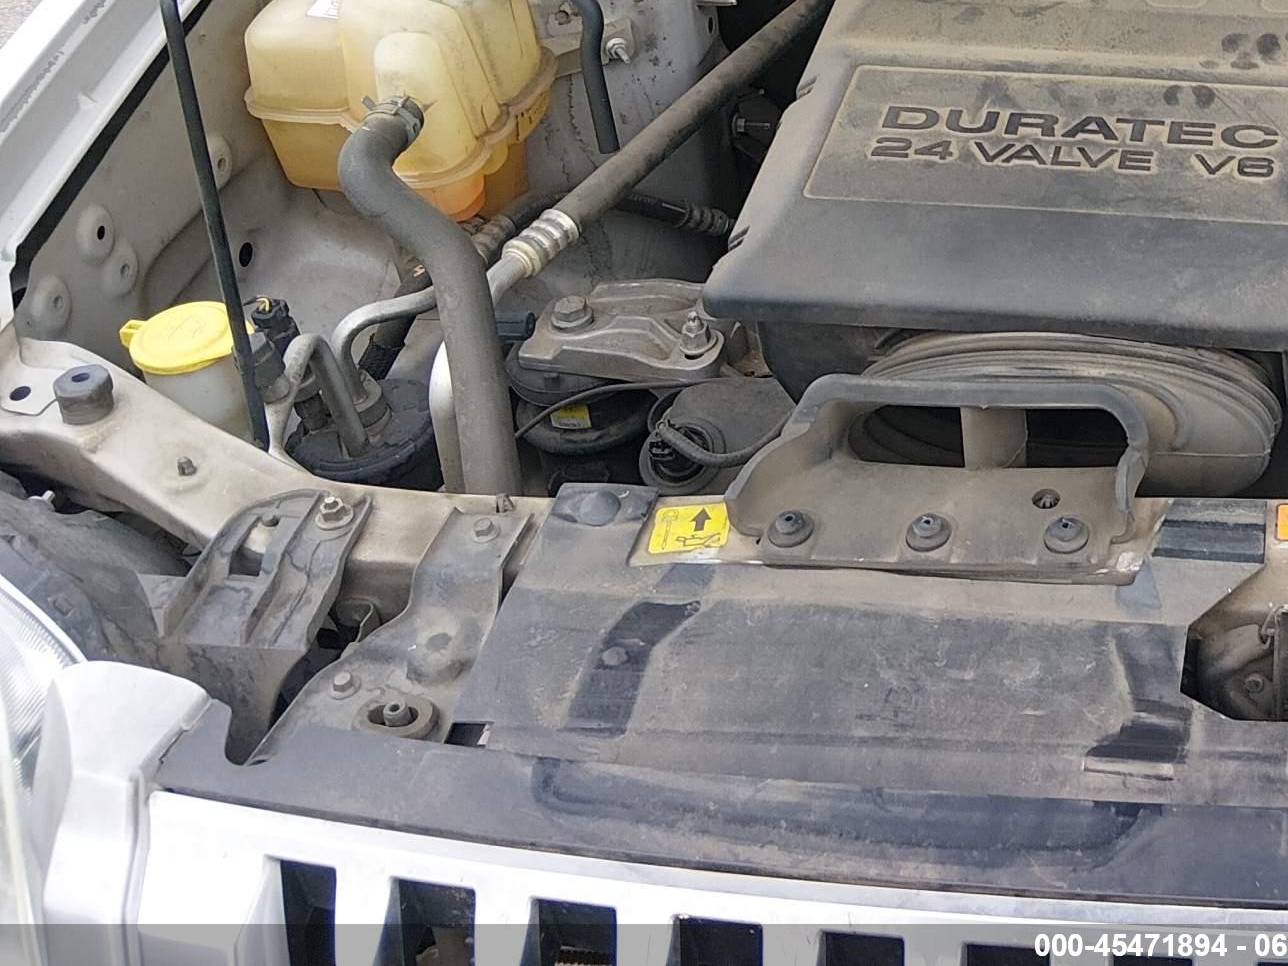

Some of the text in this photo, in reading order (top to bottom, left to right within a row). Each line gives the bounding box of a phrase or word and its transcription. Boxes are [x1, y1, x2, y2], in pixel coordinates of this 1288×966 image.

[881, 105, 1280, 150] DURATEC
[870, 136, 1275, 178] 24 VALVE V6
